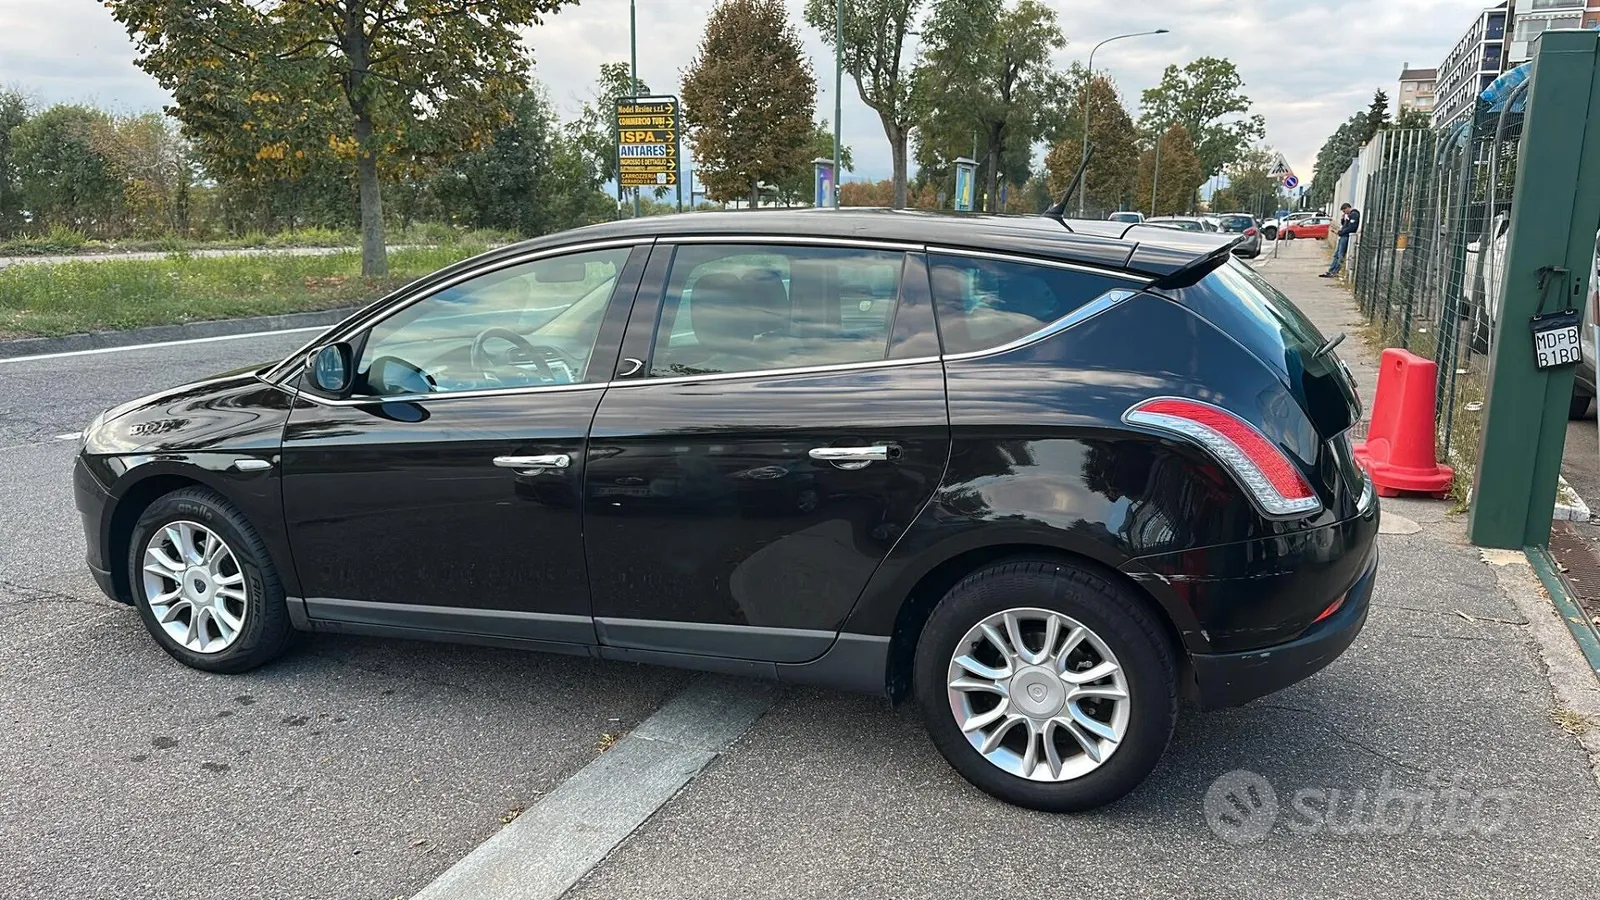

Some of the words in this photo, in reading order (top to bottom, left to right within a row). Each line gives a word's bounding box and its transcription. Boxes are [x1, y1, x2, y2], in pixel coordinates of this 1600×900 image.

[618, 117, 651, 125] COMMERCIO
[652, 117, 665, 125] TUBI
[620, 131, 656, 142] ISPA
[621, 145, 665, 156] ANTARES
[178, 503, 213, 521] apollo
